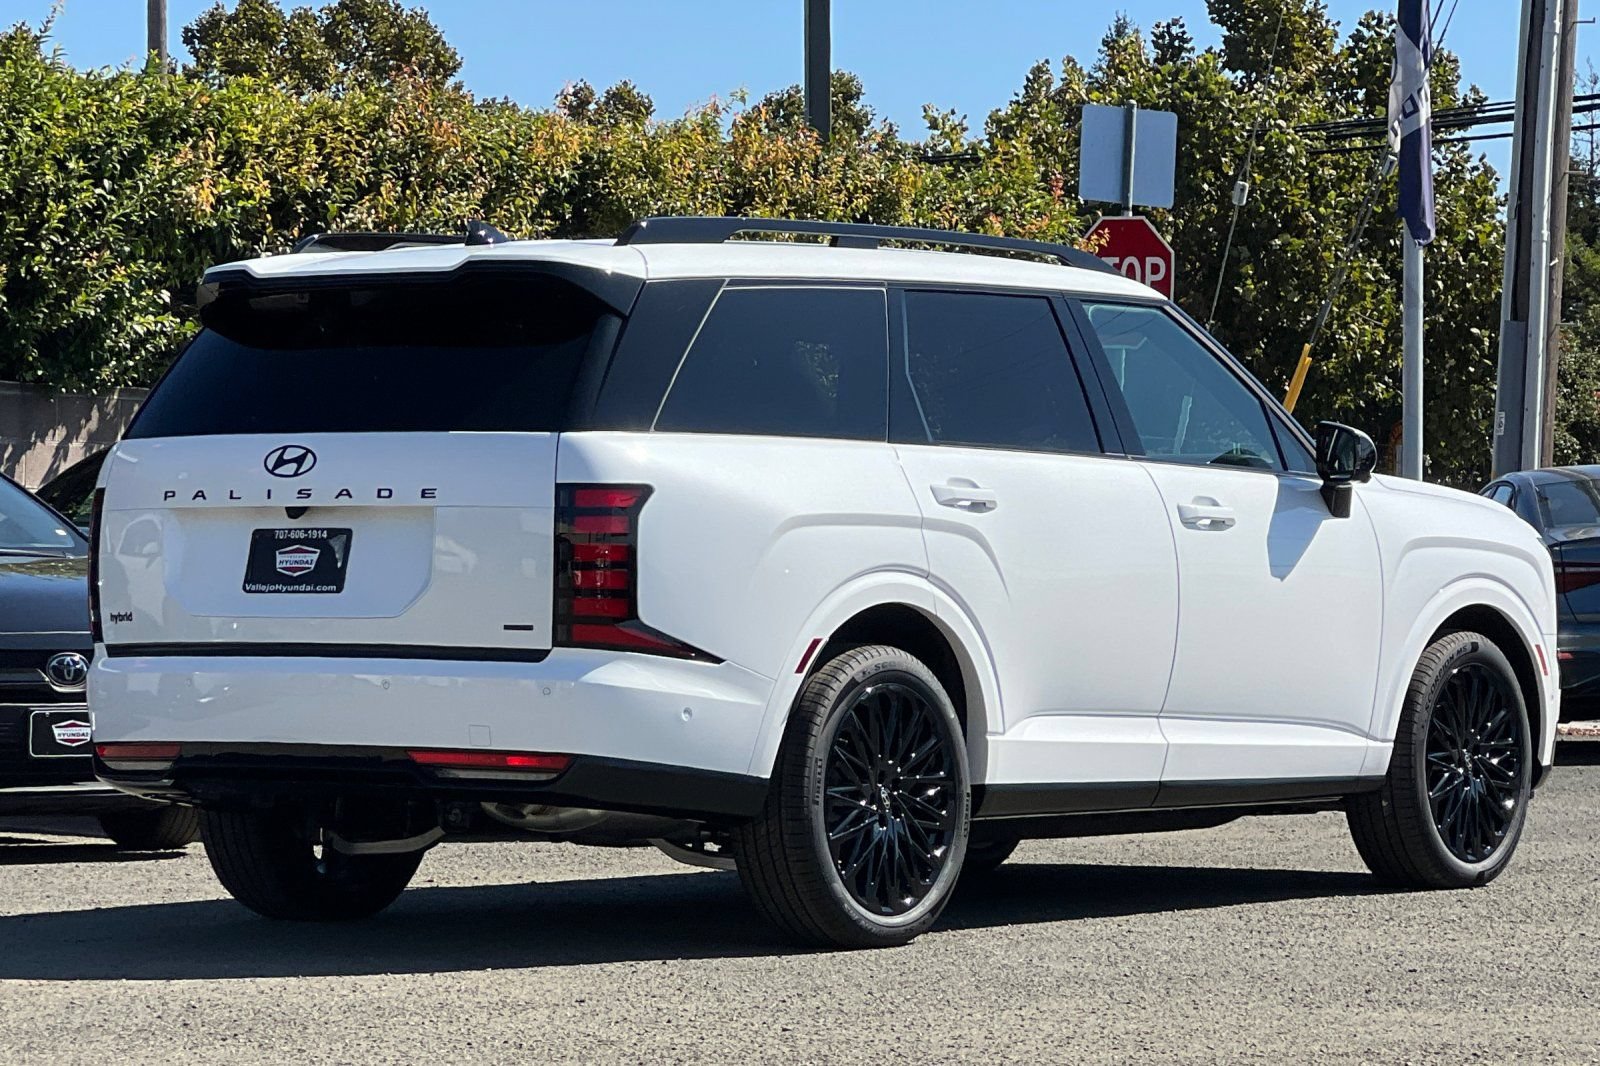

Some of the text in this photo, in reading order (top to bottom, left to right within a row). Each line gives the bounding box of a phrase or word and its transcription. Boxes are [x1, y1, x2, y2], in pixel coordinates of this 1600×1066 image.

[1101, 256, 1166, 289] OP
[164, 488, 437, 501] PALISADE
[274, 529, 328, 539] 707-606-1914
[245, 583, 337, 592] VallejoHyundai.com
[110, 611, 133, 624] hybrid
